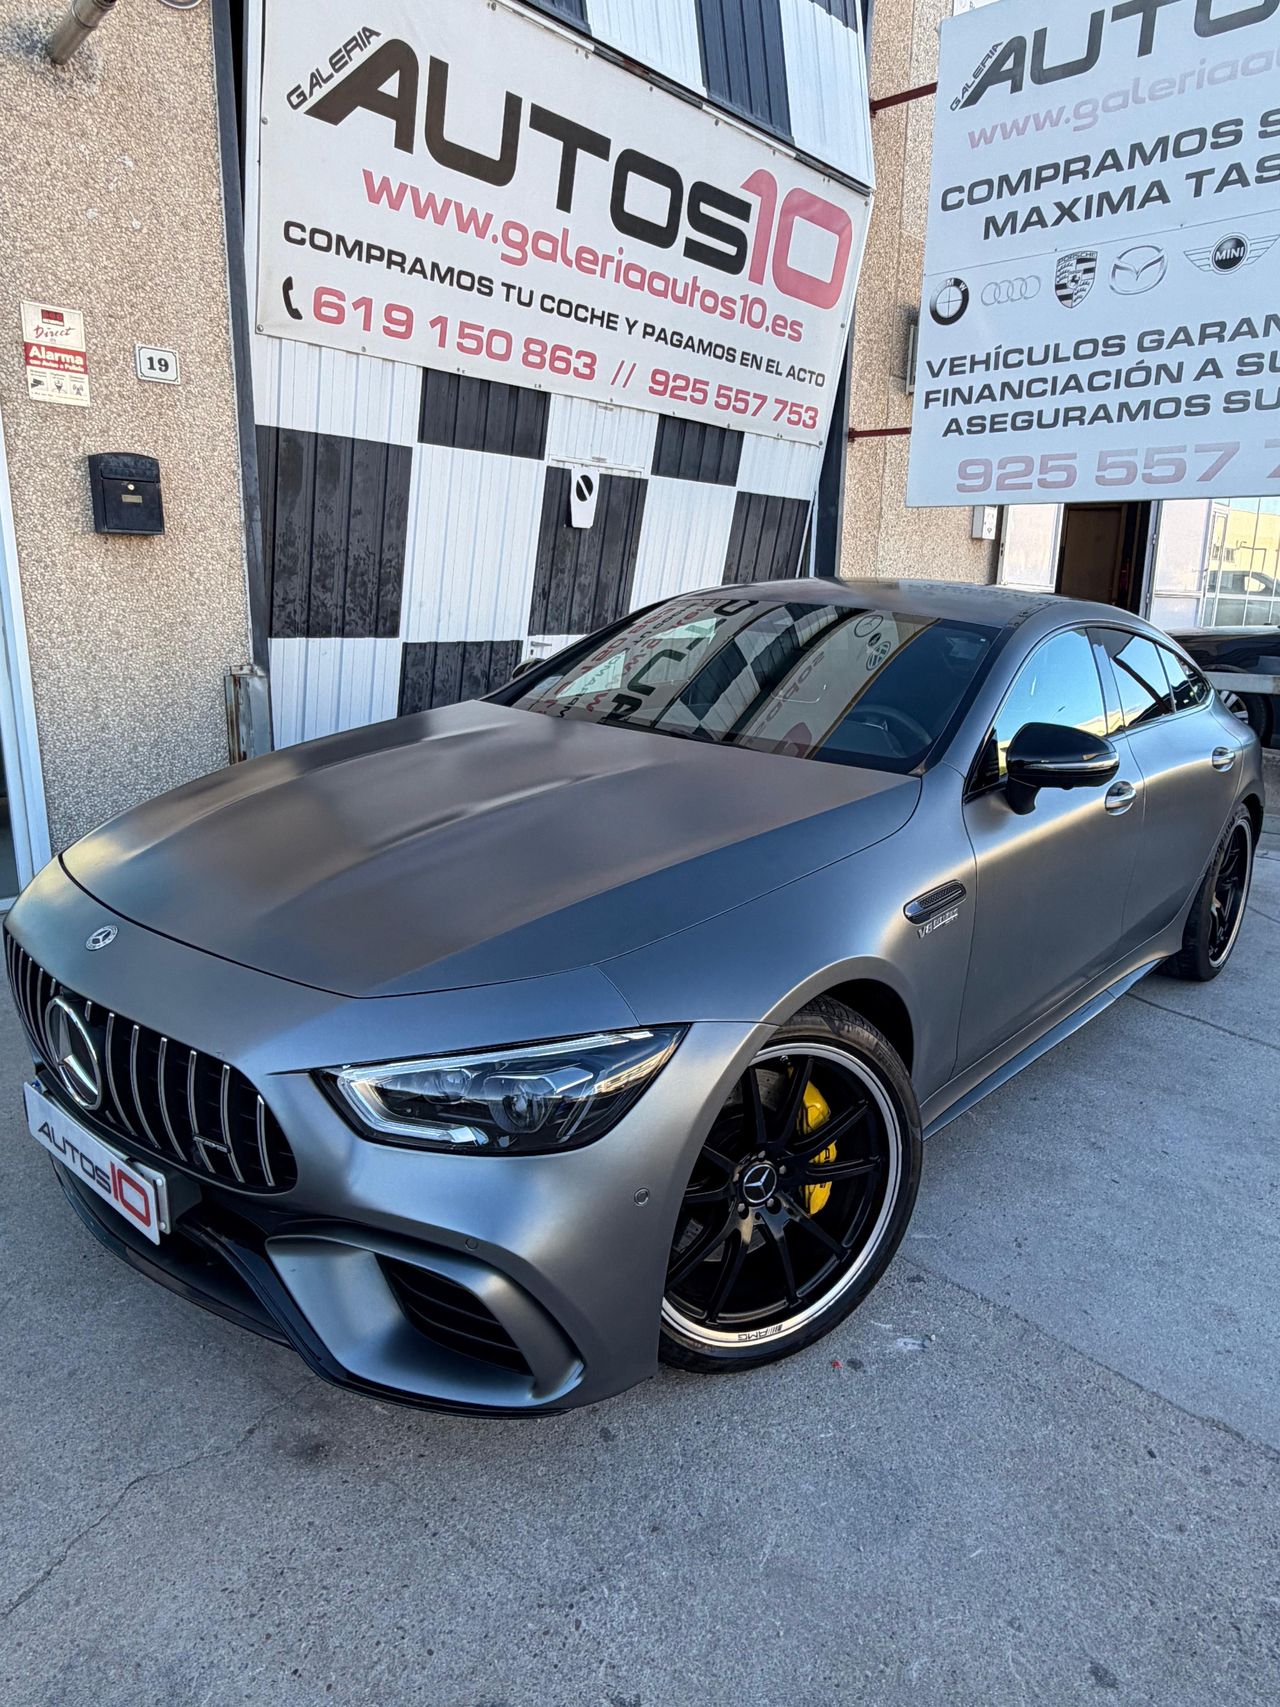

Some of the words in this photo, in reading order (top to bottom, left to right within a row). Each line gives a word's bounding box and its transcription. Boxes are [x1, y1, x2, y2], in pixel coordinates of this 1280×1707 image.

[285, 25, 382, 111] GALERIA
[949, 41, 1004, 112] GALERIA
[967, 46, 1280, 150] www.galeriaa
[303, 38, 852, 310] AUTOS10
[941, 117, 1244, 212] COMPRAMOS
[983, 179, 1171, 240] MAXIMA
[1184, 153, 1280, 198] TAS
[362, 168, 804, 343] www.galeriaautos10.es
[1214, 247, 1244, 262] MINI
[33, 324, 77, 339] Direct
[283, 220, 494, 298] COMPRAMOS
[501, 281, 534, 307] TU
[540, 293, 620, 332] COCHE
[625, 316, 639, 336] Y
[642, 322, 738, 364] PAGAMOS
[739, 350, 763, 371] EN
[764, 358, 783, 377] EL
[785, 365, 826, 388] ACTO
[29, 345, 84, 366] Alarma
[146, 355, 170, 373] 19
[312, 285, 414, 340] 619
[428, 314, 513, 363] 150
[521, 336, 598, 381] 863
[649, 367, 711, 406] 925
[714, 382, 769, 417] 557
[771, 397, 819, 430] 753
[923, 359, 1185, 410] FINANCIACIÓN
[1192, 357, 1224, 382] A
[926, 333, 1127, 379] VEHÍCULOS
[942, 393, 1211, 438] ASEGURAMOS
[1222, 386, 1280, 413] SU
[955, 452, 1078, 494] 925
[1094, 440, 1241, 487] 557
[38, 1121, 151, 1228] AUTOS10
